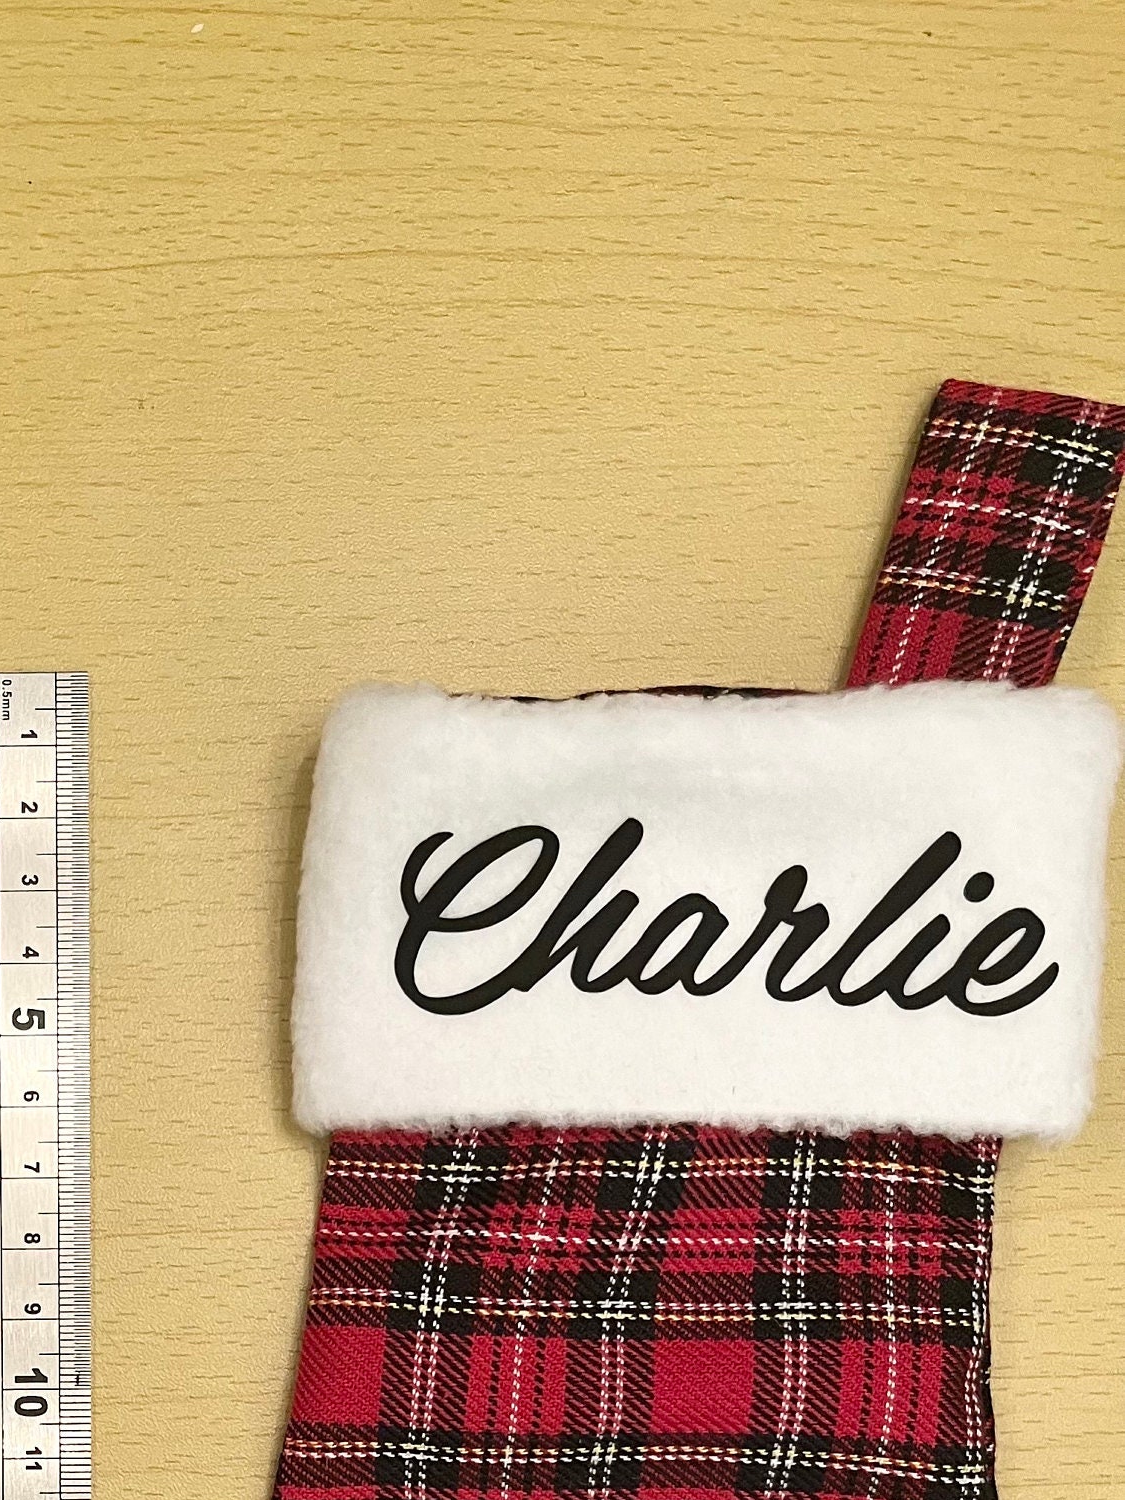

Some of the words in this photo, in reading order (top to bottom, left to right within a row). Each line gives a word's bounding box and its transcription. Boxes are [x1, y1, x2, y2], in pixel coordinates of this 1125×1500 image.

[1, 679, 13, 721] 0.5mm
[20, 729, 39, 739] 1
[20, 801, 39, 814] 2
[21, 874, 40, 887] 3
[394, 818, 1059, 1017] Charlie
[21, 945, 40, 960] 4
[11, 1007, 46, 1031] 5
[23, 1090, 40, 1103] 6
[23, 1161, 41, 1174] 7
[23, 1232, 41, 1245] 8
[23, 1302, 42, 1316] 9
[14, 1367, 49, 1417] 10
[25, 1446, 43, 1471] 11
